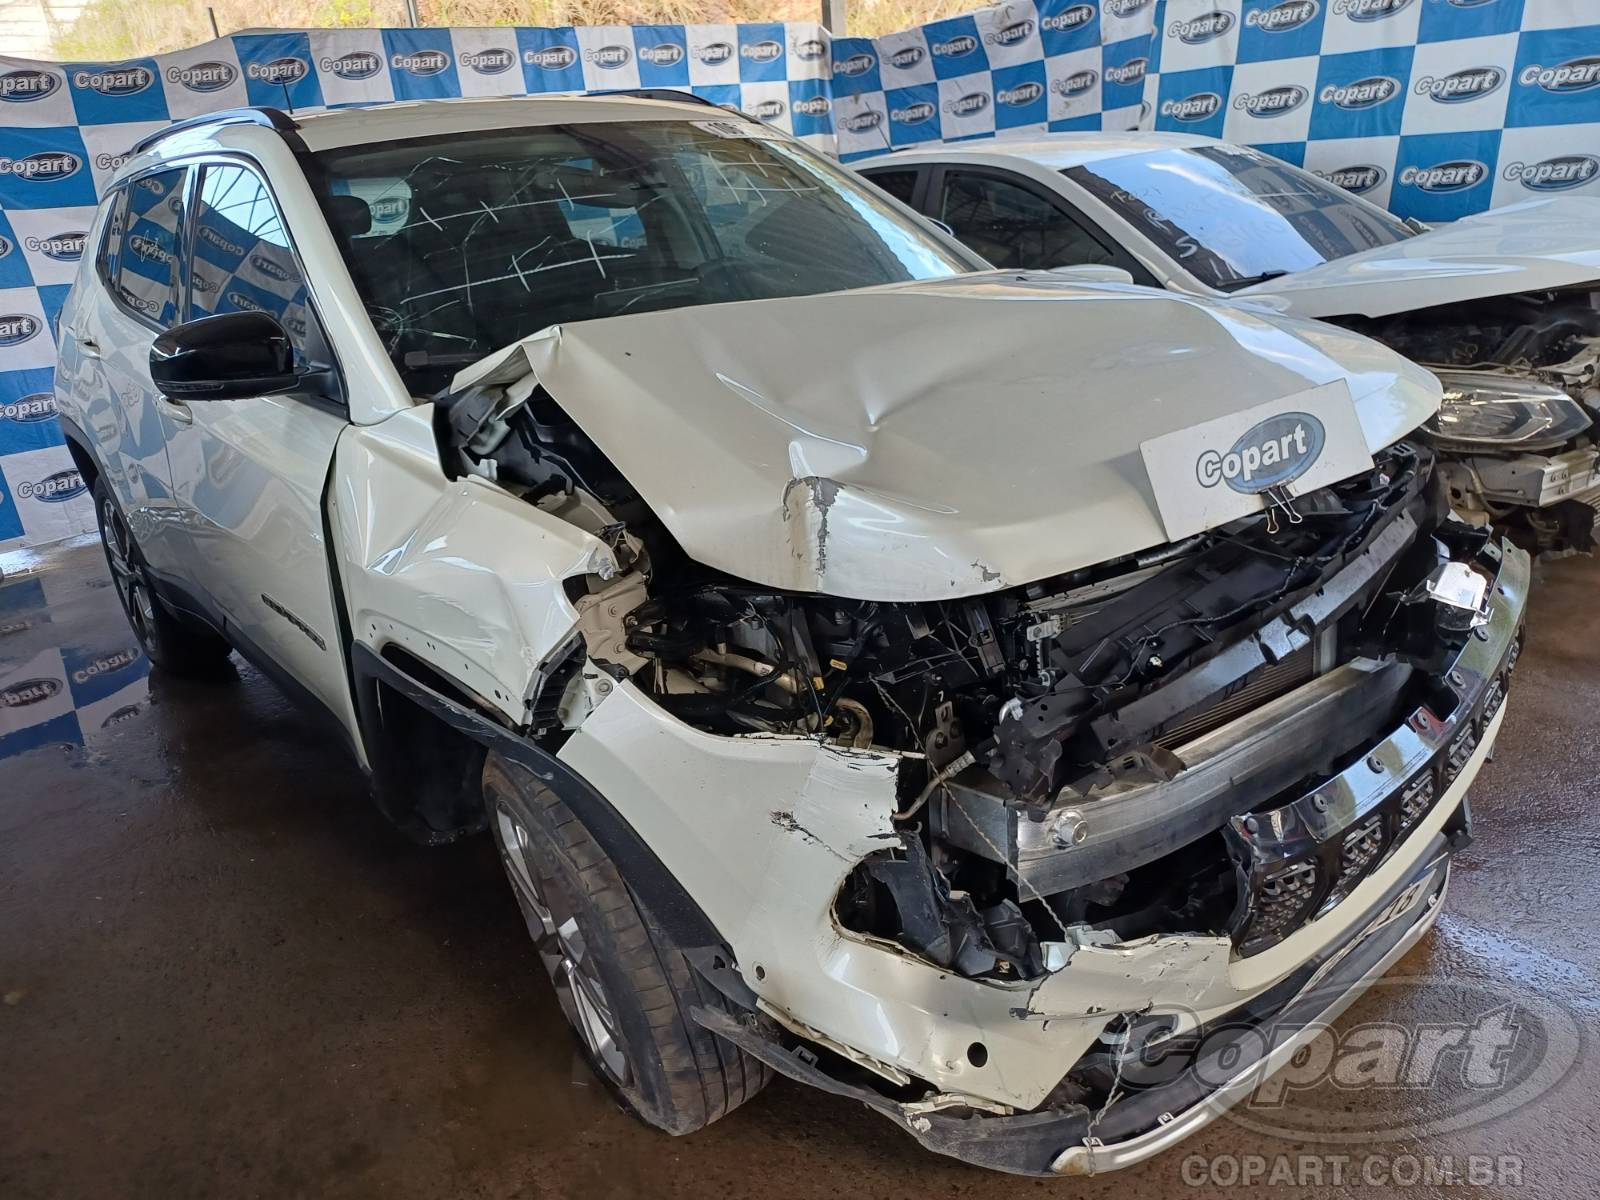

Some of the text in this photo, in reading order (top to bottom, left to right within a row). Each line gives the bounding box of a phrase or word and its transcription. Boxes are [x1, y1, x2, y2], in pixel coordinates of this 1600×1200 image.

[1042, 8, 1089, 29] Copart
[1247, 3, 1310, 26] Copart
[986, 22, 1029, 45] Copart
[1169, 15, 1226, 37] Copart
[585, 50, 625, 63] Copart
[639, 46, 678, 61] Copart
[742, 44, 778, 58] Copart
[933, 38, 973, 56] Copart
[320, 56, 375, 72] Copart
[391, 55, 443, 69] Copart
[460, 52, 508, 68] Copart
[525, 50, 570, 66] Copart
[833, 56, 870, 73] Copart
[168, 65, 229, 83] Copart
[248, 62, 300, 78] Copart
[1105, 60, 1146, 82] Copart
[0, 73, 49, 95] part
[74, 70, 146, 92] Copart
[1052, 72, 1092, 94] Copart
[1321, 81, 1390, 102] Copart
[1415, 71, 1494, 94] Copart
[943, 94, 984, 113] Copart
[997, 83, 1037, 103] Copart
[1234, 89, 1297, 110] Copart
[891, 104, 930, 121] Copart
[1161, 95, 1216, 116] Copart
[0, 157, 72, 178] Copart
[1400, 164, 1483, 189] Copart
[1504, 156, 1593, 185] Copart
[369, 201, 404, 217] opart
[1197, 424, 1307, 488] Copart
